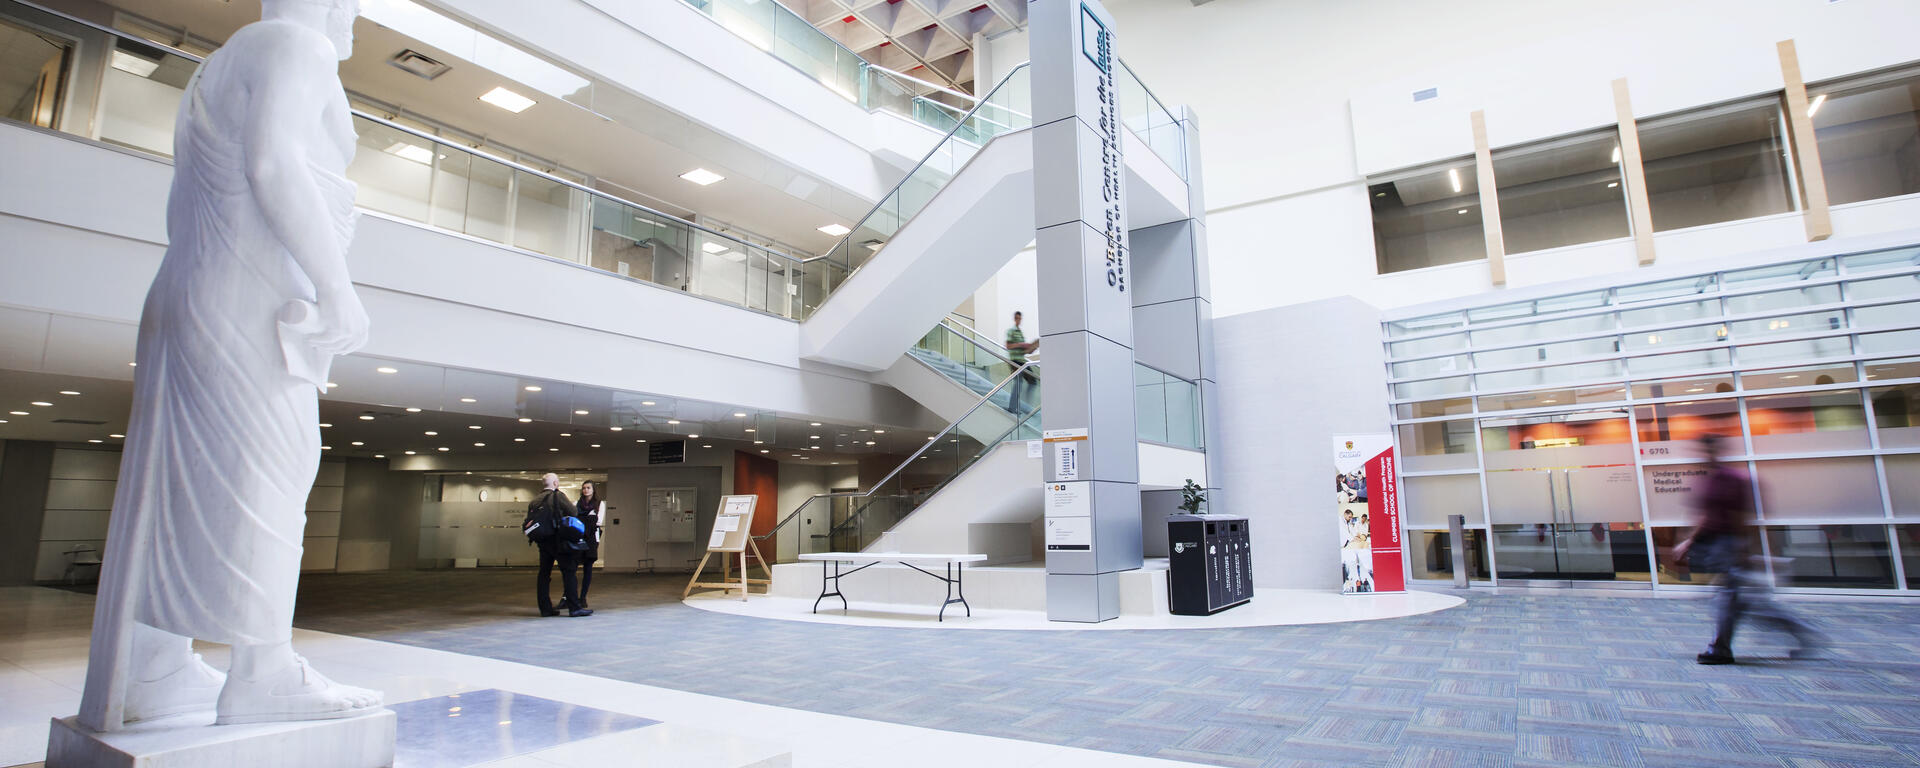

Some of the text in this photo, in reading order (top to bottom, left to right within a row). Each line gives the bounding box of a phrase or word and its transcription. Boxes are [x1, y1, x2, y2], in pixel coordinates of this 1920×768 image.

[1097, 76, 1106, 104] the
[1099, 106, 1110, 139] for
[1109, 92, 1117, 151] SCIENCES
[1102, 138, 1112, 202] Centre
[1112, 154, 1120, 200] HEALTH
[1114, 204, 1121, 221] OF
[1105, 209, 1117, 287] O'Brien
[1116, 226, 1125, 292] BACHELOR
[1388, 484, 1394, 492] OF
